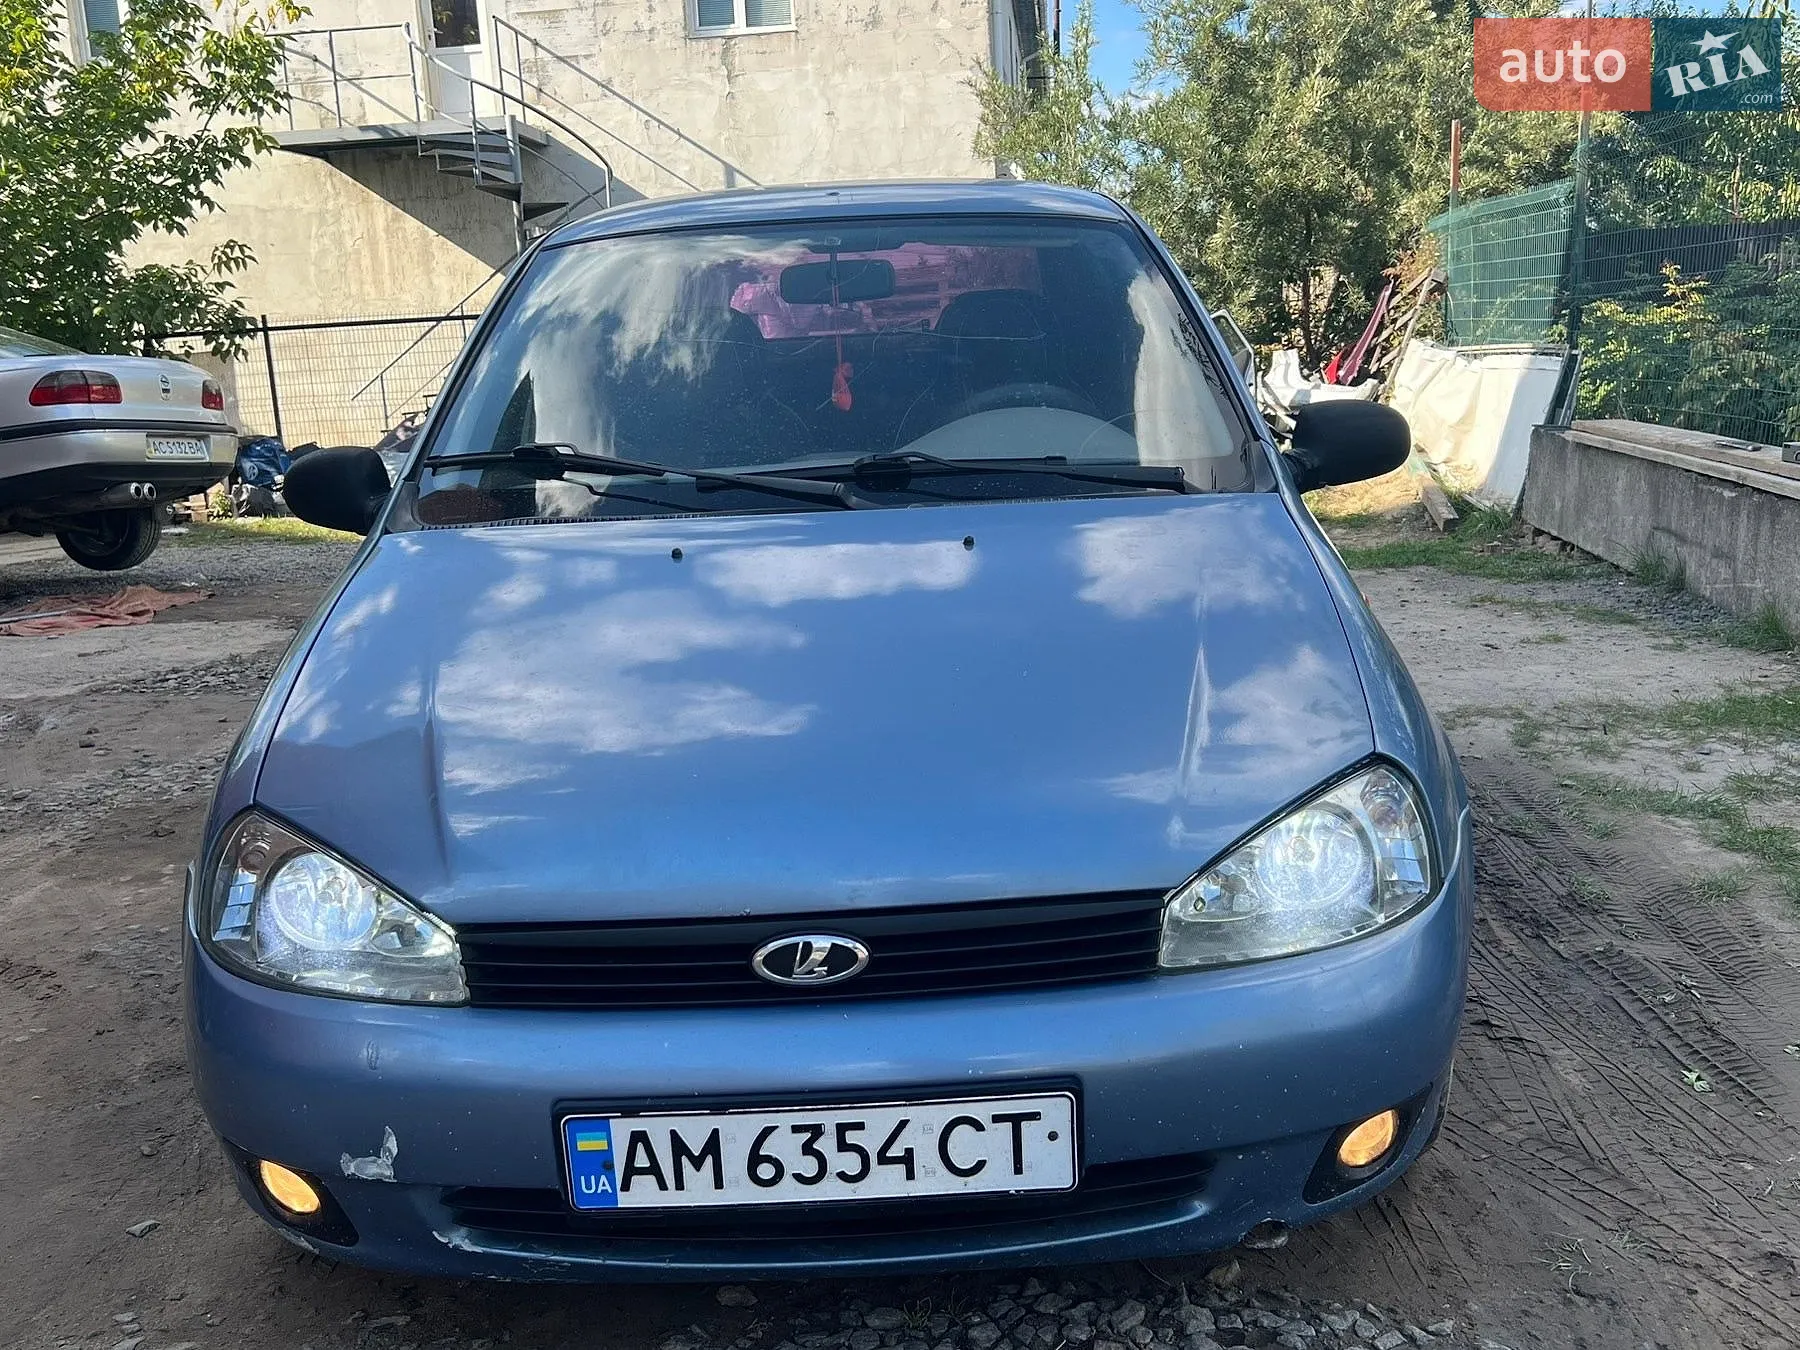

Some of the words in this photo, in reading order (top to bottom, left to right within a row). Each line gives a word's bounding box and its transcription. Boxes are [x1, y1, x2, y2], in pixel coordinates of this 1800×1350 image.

[620, 1128, 724, 1191] AM
[747, 1119, 915, 1187] 6354
[938, 1111, 1042, 1178] CT
[581, 1175, 612, 1193] UA
